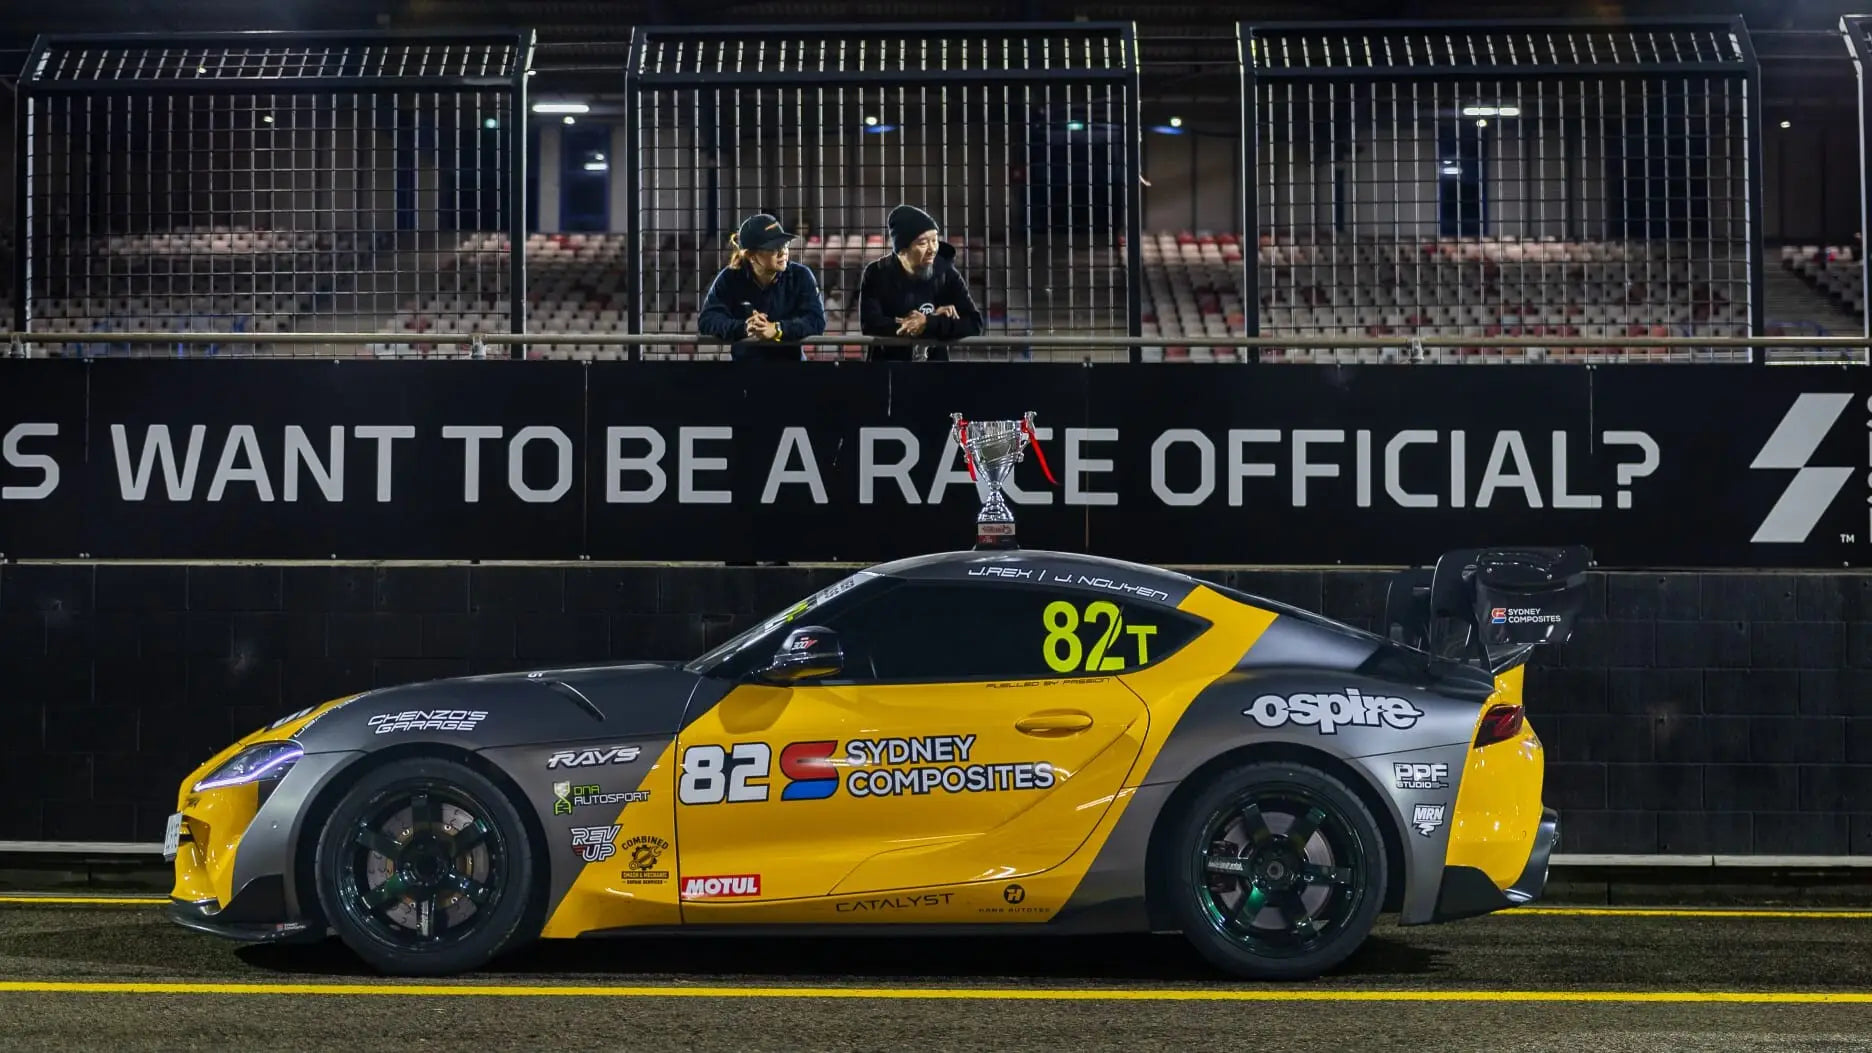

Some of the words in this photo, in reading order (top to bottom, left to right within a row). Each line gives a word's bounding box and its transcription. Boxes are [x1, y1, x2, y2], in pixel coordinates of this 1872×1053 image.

[111, 423, 416, 503] WANT
[442, 425, 573, 504] TO
[606, 426, 732, 504] BE
[760, 426, 829, 504] A
[1150, 428, 1660, 509] OFFICIAL?
[1840, 534, 1855, 543] TM
[968, 566, 1033, 579] J.REX
[1077, 575, 1169, 600] NGUYEN
[1508, 608, 1541, 616] SYDNEY
[1508, 615, 1561, 623] COMPOSITES
[368, 710, 488, 726] CHENZO'S
[375, 720, 477, 734] GARAGE
[548, 747, 641, 768] RAYS
[847, 734, 976, 766] SYDNEY
[679, 741, 772, 805] 82
[847, 762, 1055, 797] COMPOSITES
[1395, 764, 1448, 781] PPF
[574, 785, 600, 795] DNA
[574, 791, 650, 805] AUTOSPORT
[1414, 805, 1445, 822] MRN
[570, 825, 622, 846] REV
[622, 836, 669, 850] COMBINED
[583, 844, 616, 861] UP
[685, 877, 758, 896] MOTUL
[835, 893, 956, 913] CATALYST
